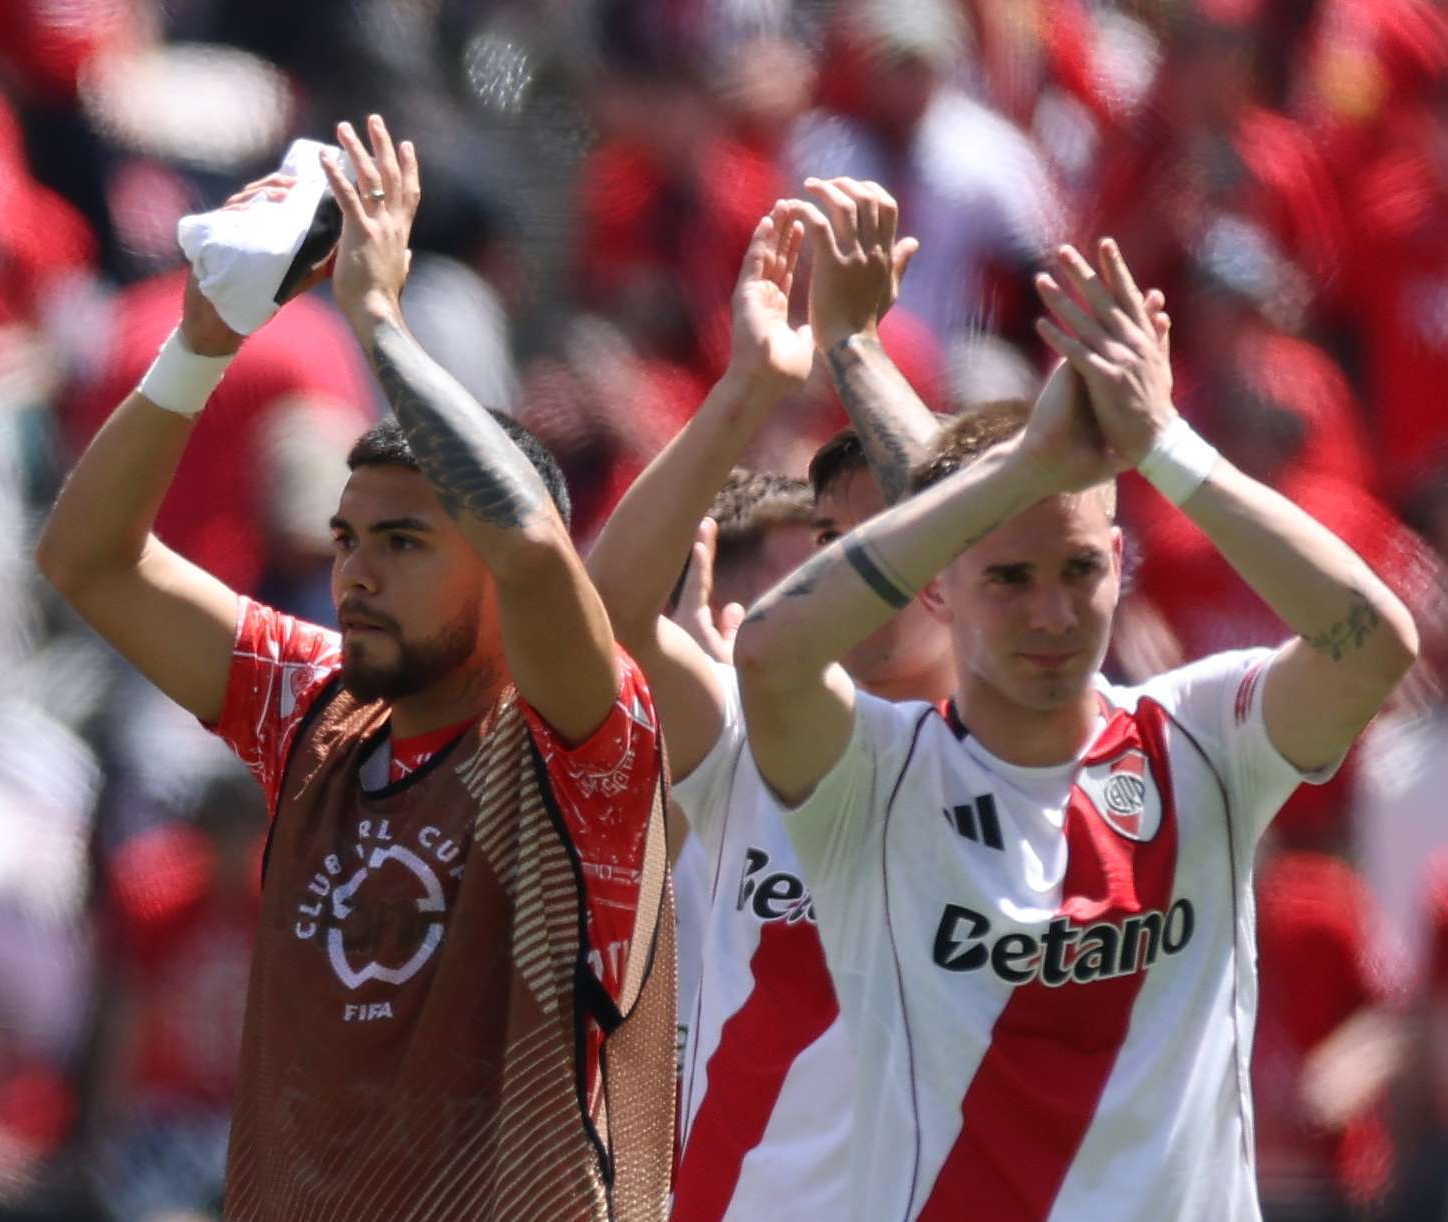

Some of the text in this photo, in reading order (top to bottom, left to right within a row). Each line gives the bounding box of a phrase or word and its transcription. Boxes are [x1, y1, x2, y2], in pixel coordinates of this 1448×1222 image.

[295, 854, 343, 940] CLUB
[932, 897, 1196, 989] Betano
[343, 1002, 394, 1021] FIFA
